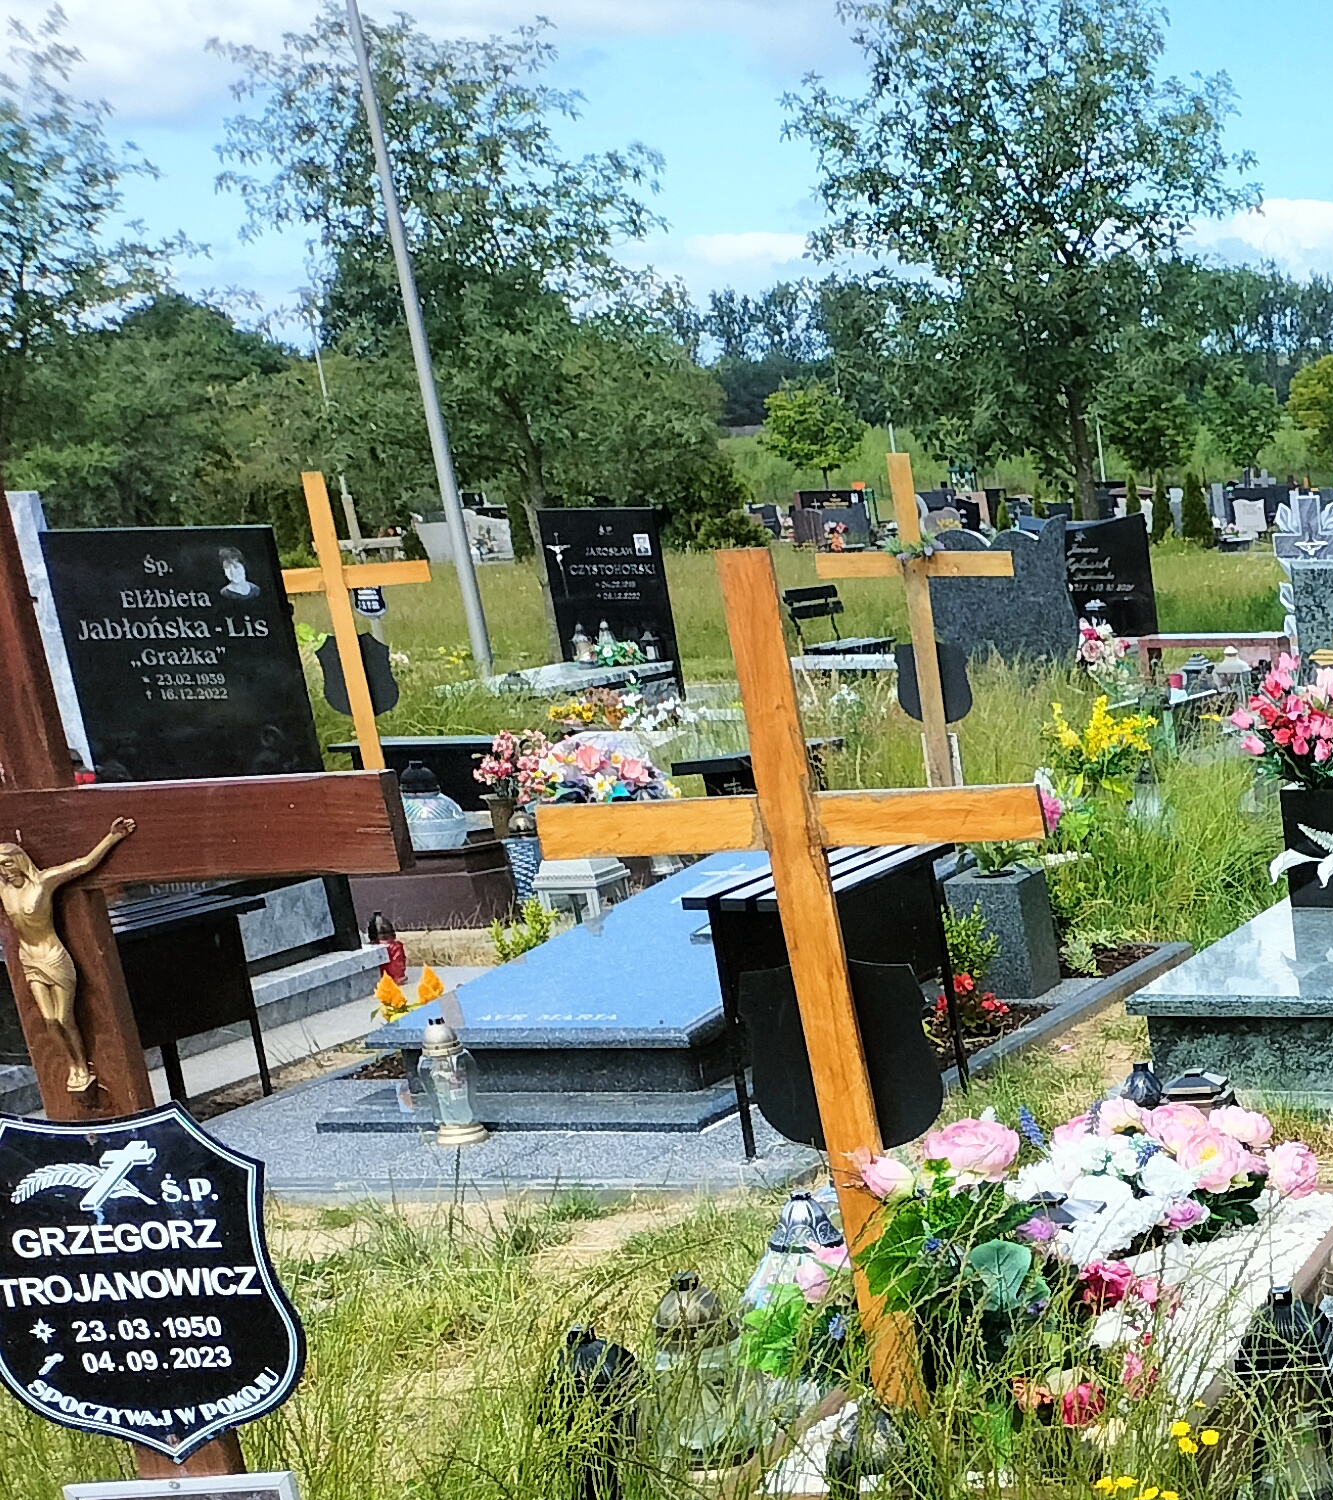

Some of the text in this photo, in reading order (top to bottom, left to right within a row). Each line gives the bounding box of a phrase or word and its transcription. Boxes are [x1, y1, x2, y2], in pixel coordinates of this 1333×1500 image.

[569, 563, 656, 576] CZYSTOHORSKI
[120, 588, 212, 609] Elżbieta
[160, 687, 229, 701] 16.12.2022
[160, 1172, 219, 1204] Ś.P.
[11, 1219, 223, 1259] GRZEGORZ
[0, 1265, 262, 1308] TROJANOWICZ
[71, 1315, 223, 1343] 23.03.1950
[81, 1345, 233, 1374] 04.09.2023
[26, 1366, 280, 1428] SPOCZYWAJ W POKOJU
